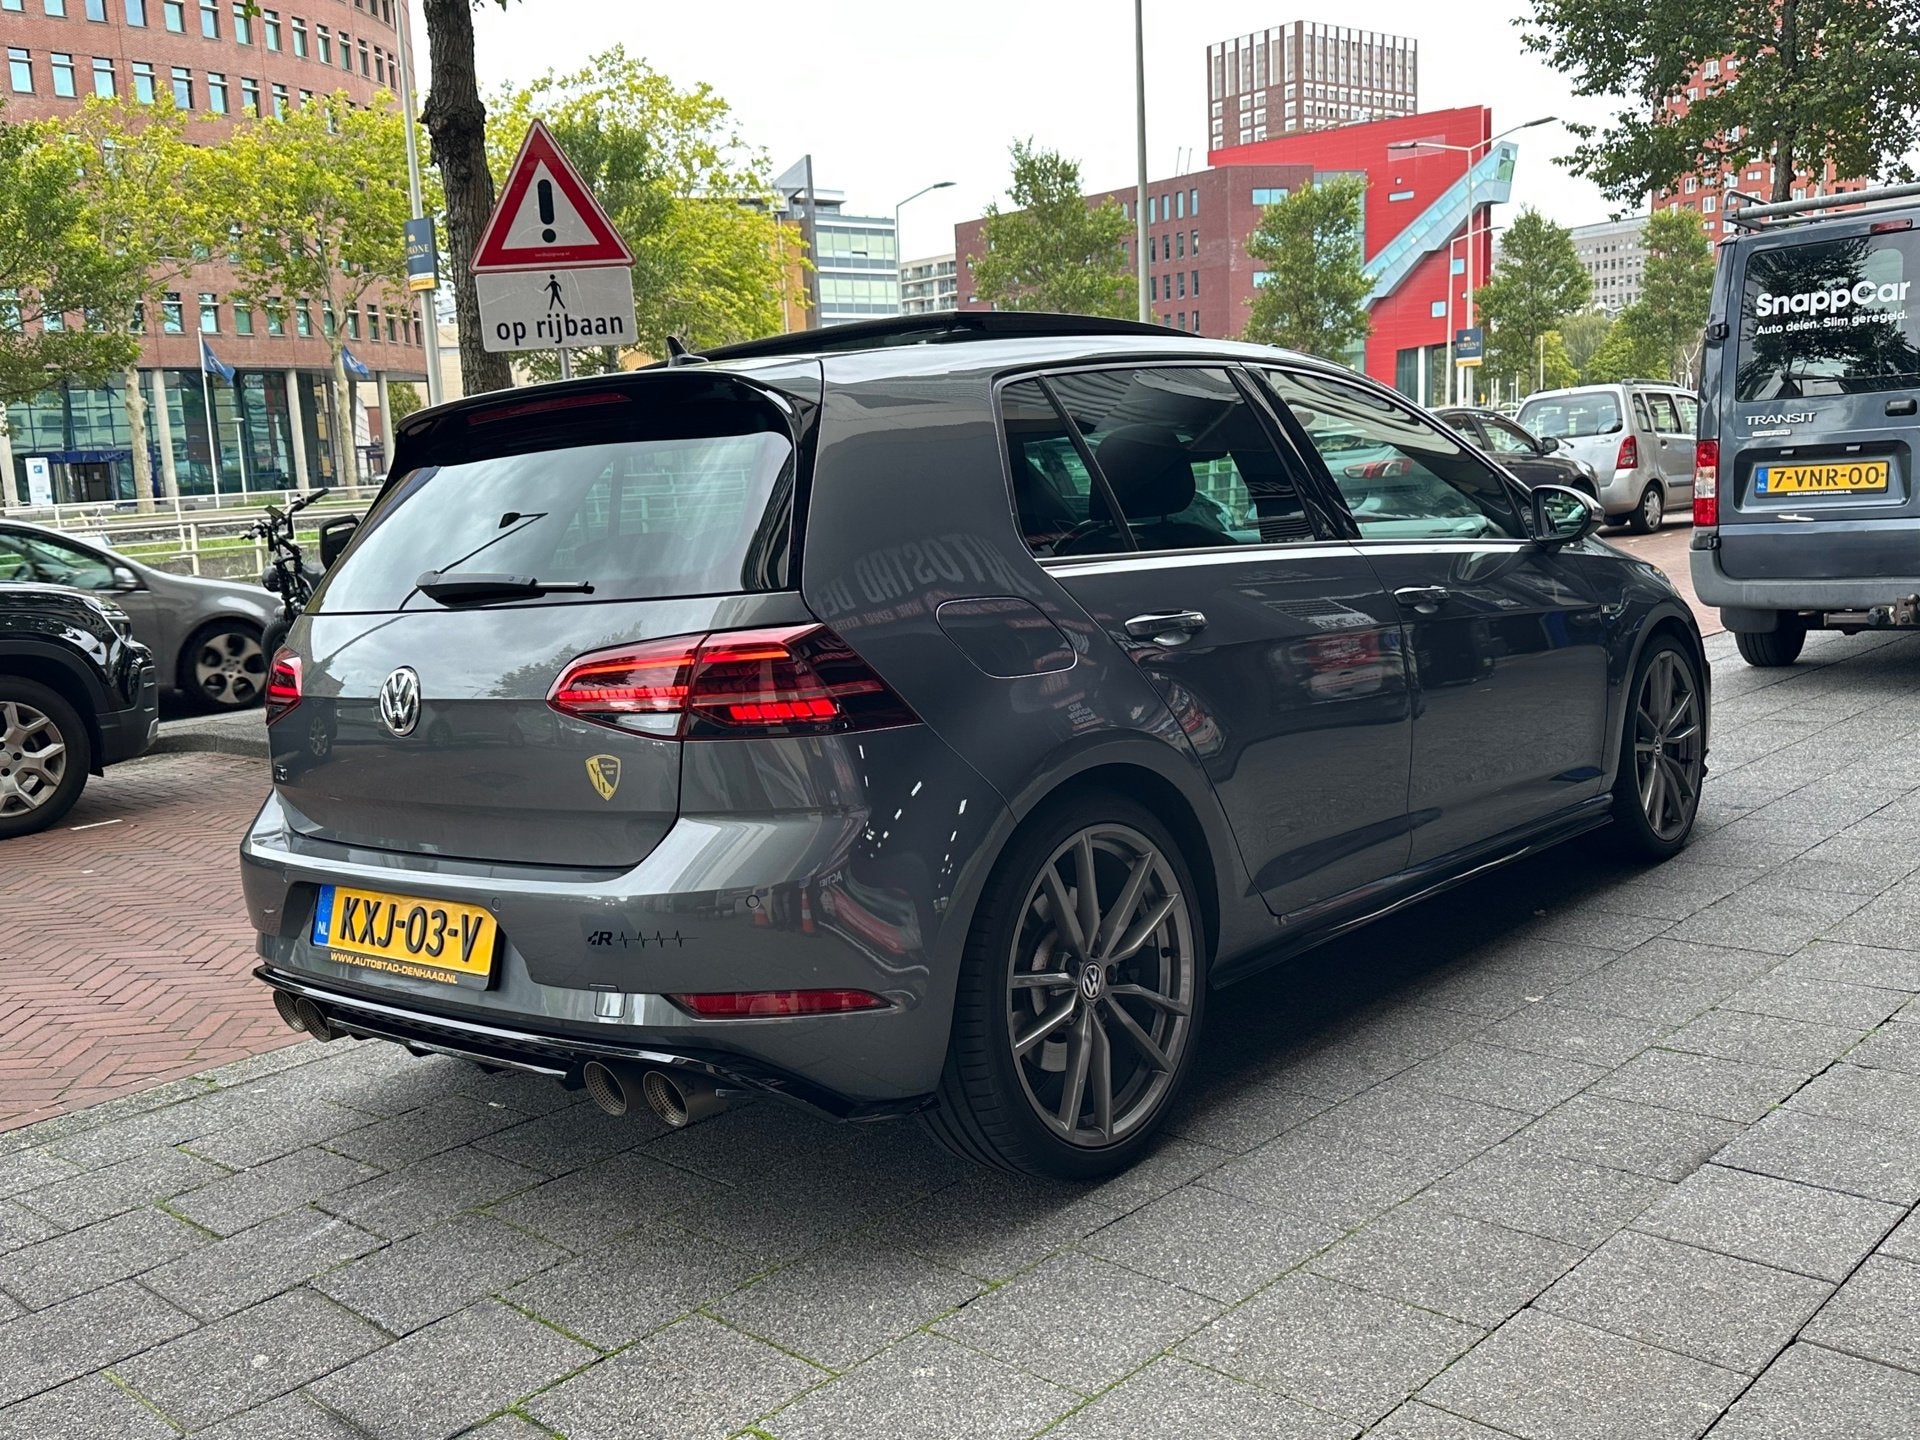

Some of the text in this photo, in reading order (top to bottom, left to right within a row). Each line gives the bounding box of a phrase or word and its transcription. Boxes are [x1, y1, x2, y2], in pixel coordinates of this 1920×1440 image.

[1756, 280, 1911, 317] SnappCar
[496, 313, 624, 346] op rijbaan
[1756, 309, 1908, 335] Auto delen. Slim geregeld.
[1745, 412, 1816, 426] TRANSIT
[1773, 466, 1880, 489] 7-VNR-00
[317, 920, 328, 936] NL
[340, 896, 483, 963] KXJ-03-V
[330, 951, 458, 985] WWW.AUTOSTAD-DENHAAG.NL
